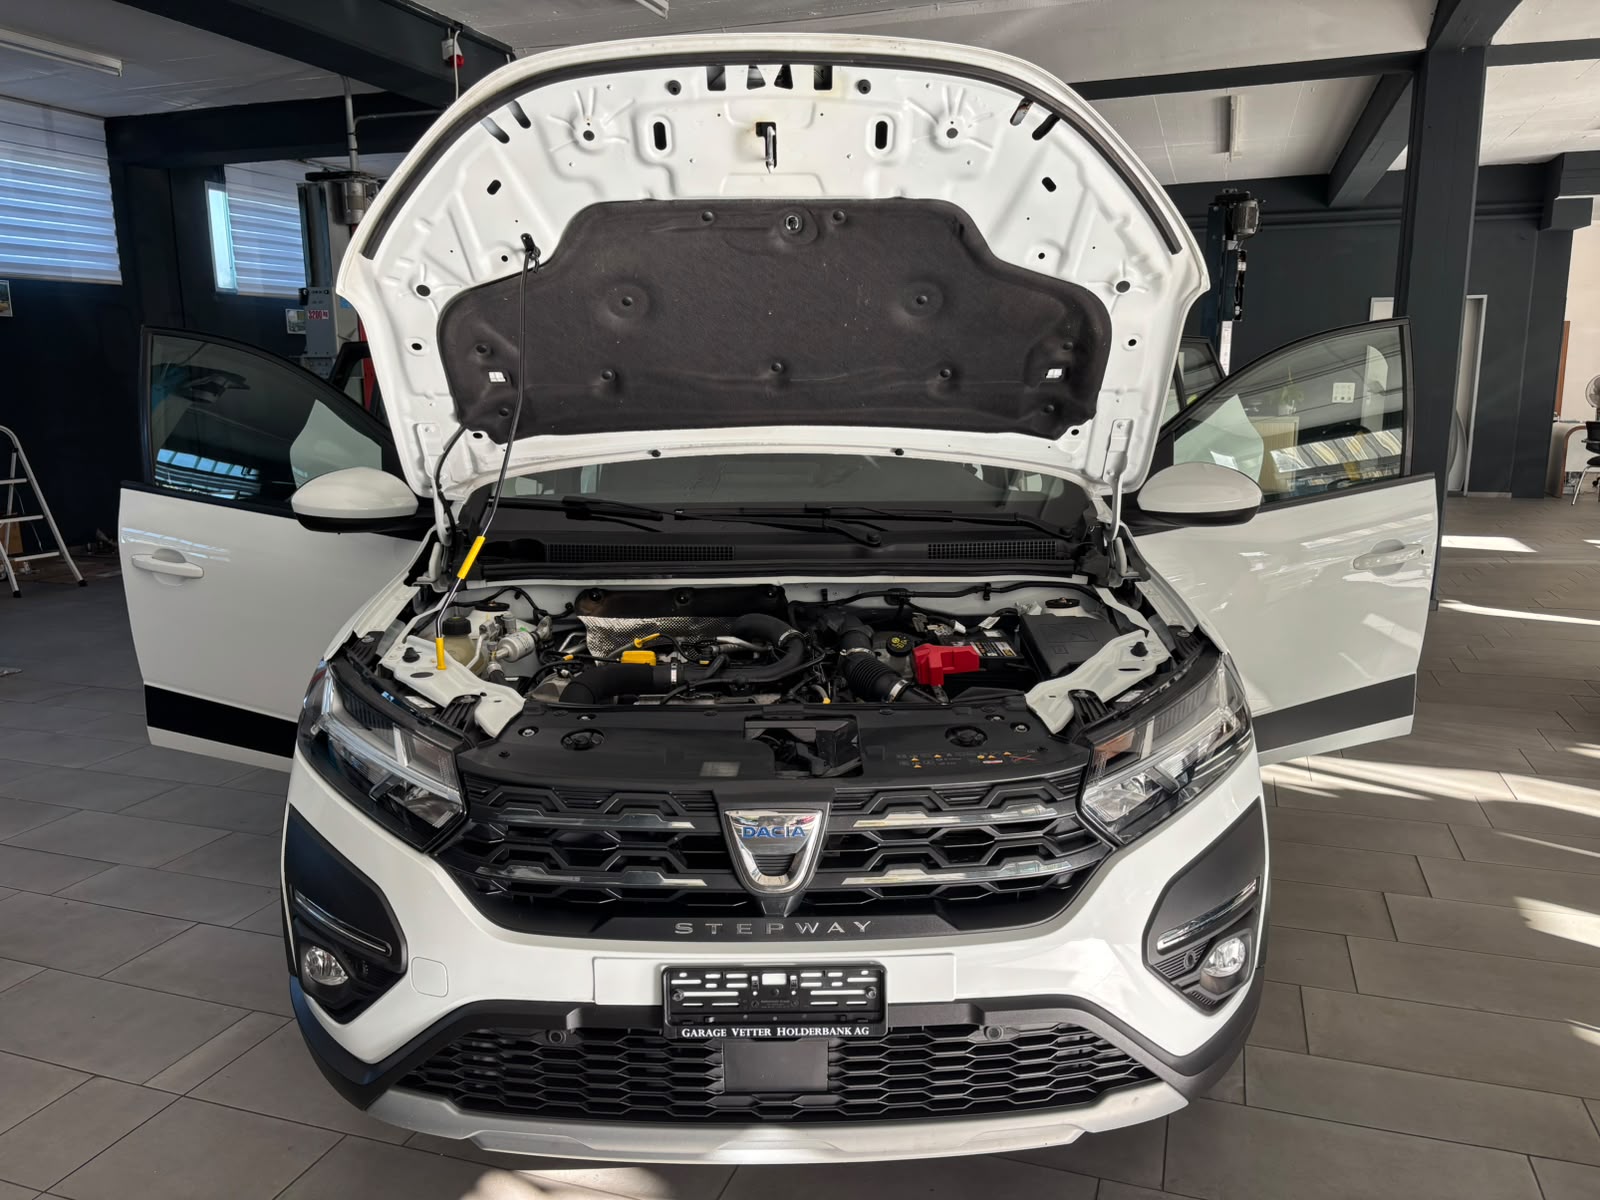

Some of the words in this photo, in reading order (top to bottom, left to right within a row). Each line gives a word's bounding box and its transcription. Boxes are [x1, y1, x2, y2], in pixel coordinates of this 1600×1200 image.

[742, 826, 806, 838] DACIA
[674, 920, 871, 935] STEPWAY
[681, 1028, 727, 1037] GARAGE
[731, 1027, 772, 1037] VETTER
[776, 1026, 852, 1037] HOLDERBANK
[854, 1026, 870, 1036] AG
